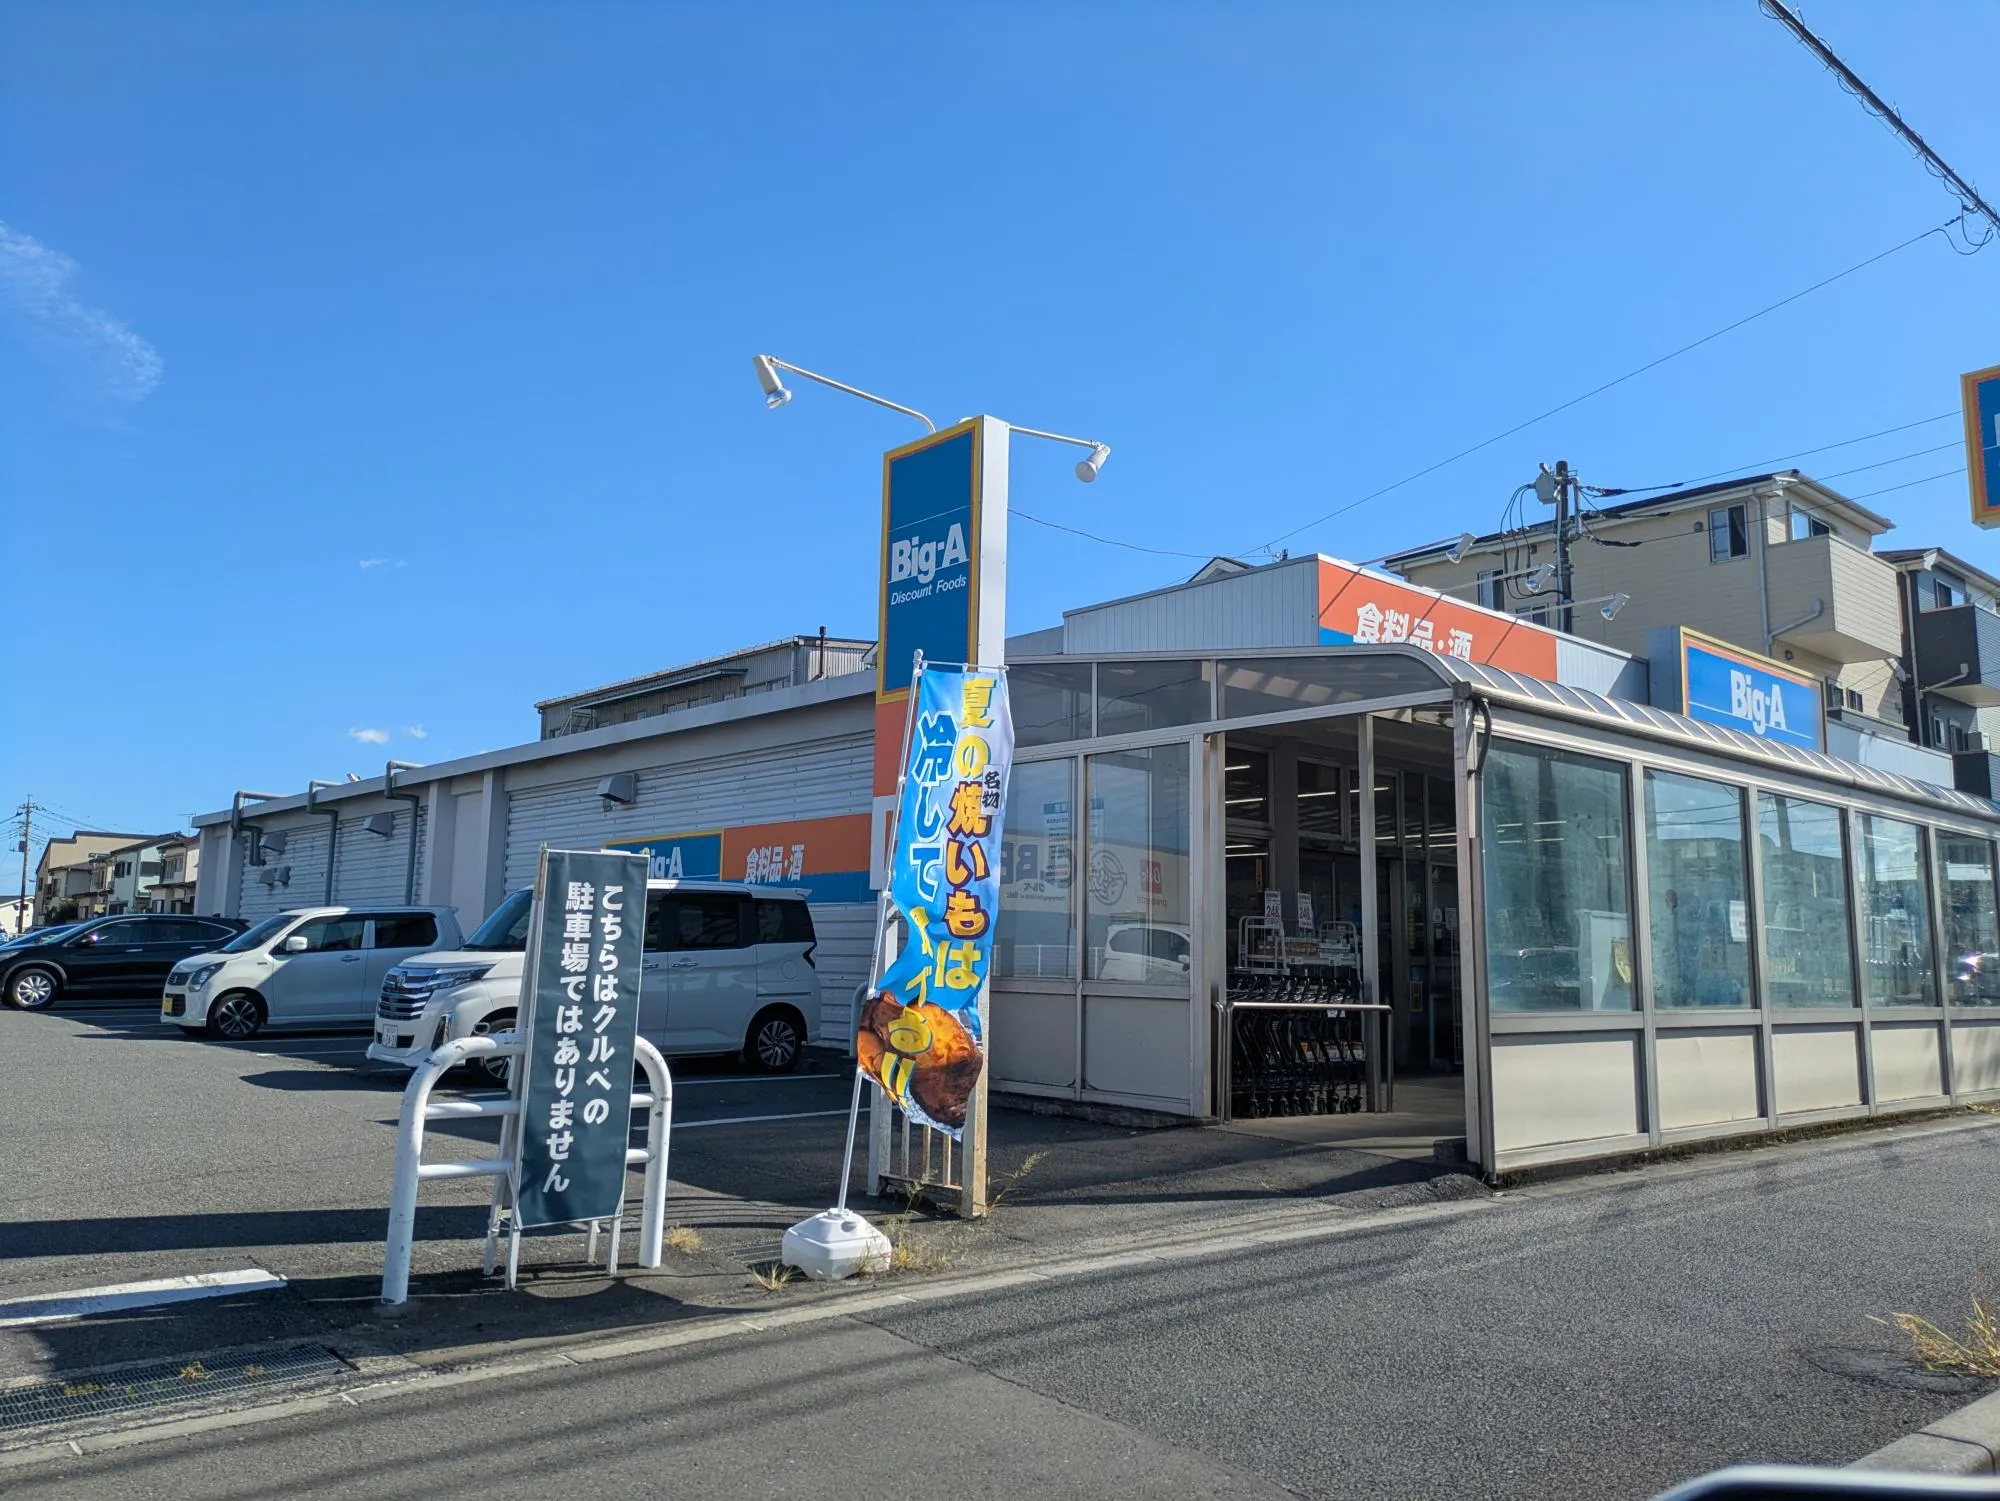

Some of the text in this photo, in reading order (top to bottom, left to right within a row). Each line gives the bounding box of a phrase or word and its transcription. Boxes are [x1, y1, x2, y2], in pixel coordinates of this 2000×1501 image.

[892, 524, 968, 583] Big-A
[891, 574, 967, 605] Discount Foods
[1730, 669, 1787, 735] Big-A
[982, 771, 1001, 809] 名物
[650, 847, 684, 879] ig-A
[583, 884, 624, 1125] こちらはクルベの
[542, 881, 595, 1194] 駐車場ではありません
